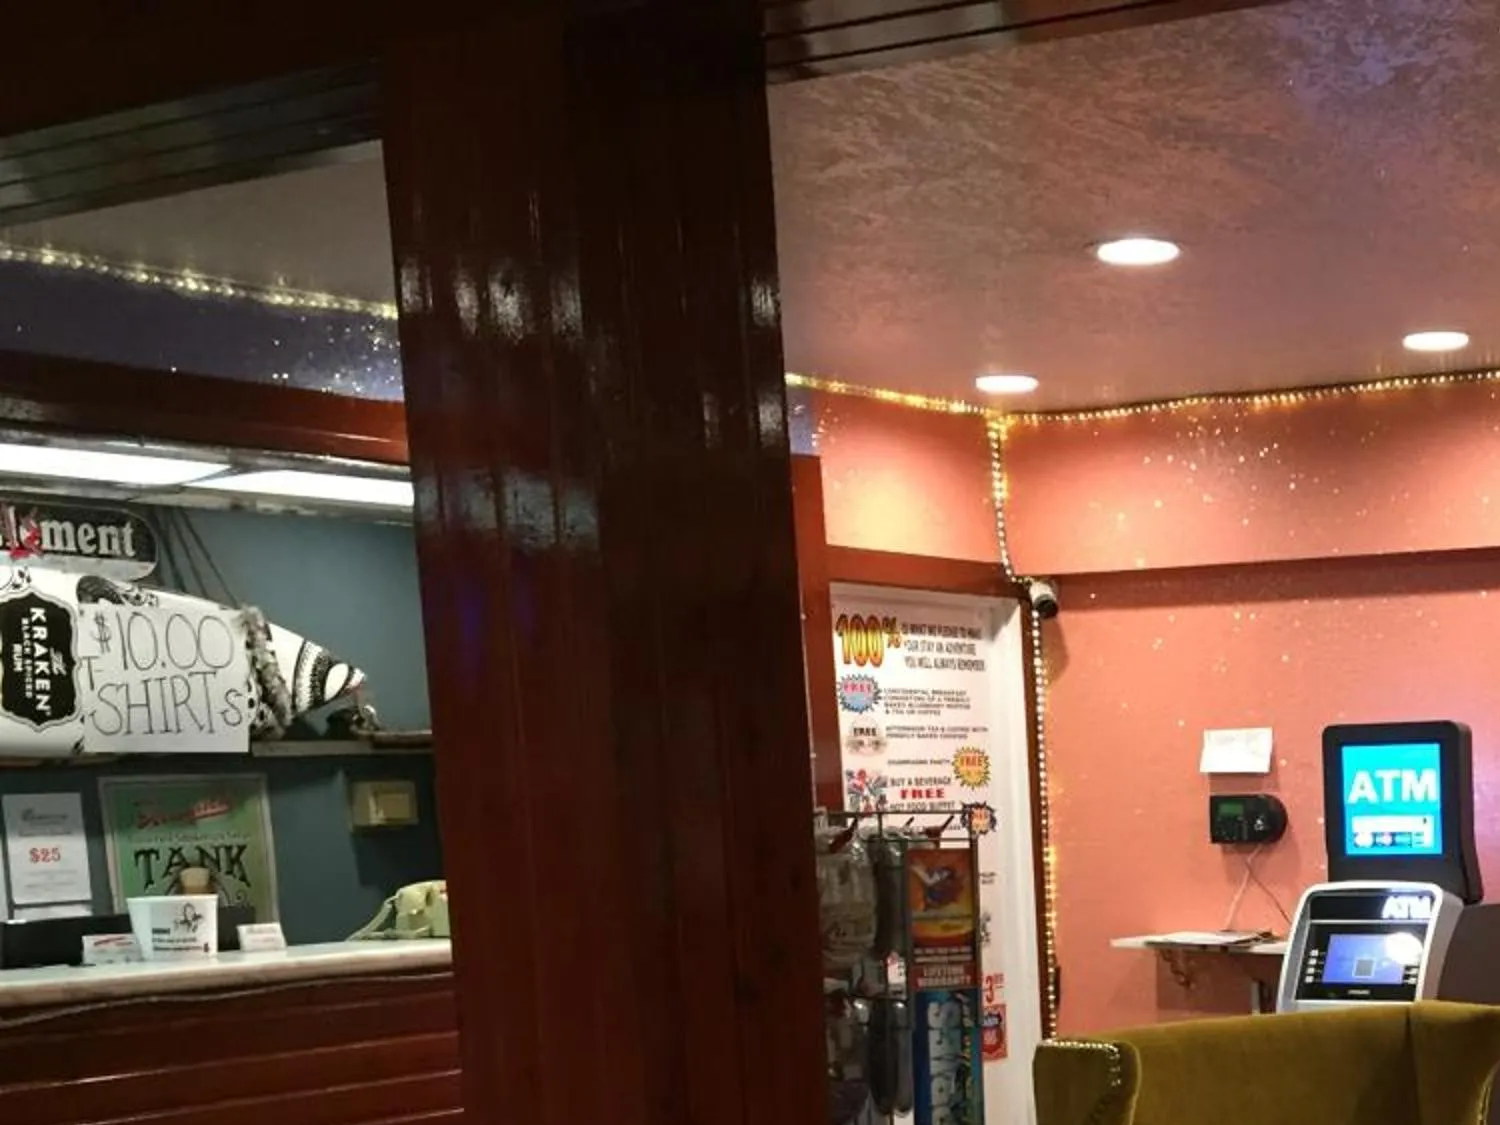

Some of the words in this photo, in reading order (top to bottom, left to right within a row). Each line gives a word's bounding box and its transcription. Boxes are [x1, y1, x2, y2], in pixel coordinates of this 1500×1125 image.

[0, 505, 136, 557] lement
[13, 643, 23, 672] RUM
[30, 607, 51, 711] KRAKEN
[900, 788, 945, 799] FREE
[1348, 768, 1438, 804] ATM
[29, 847, 62, 864] $25
[133, 844, 251, 891] TANK
